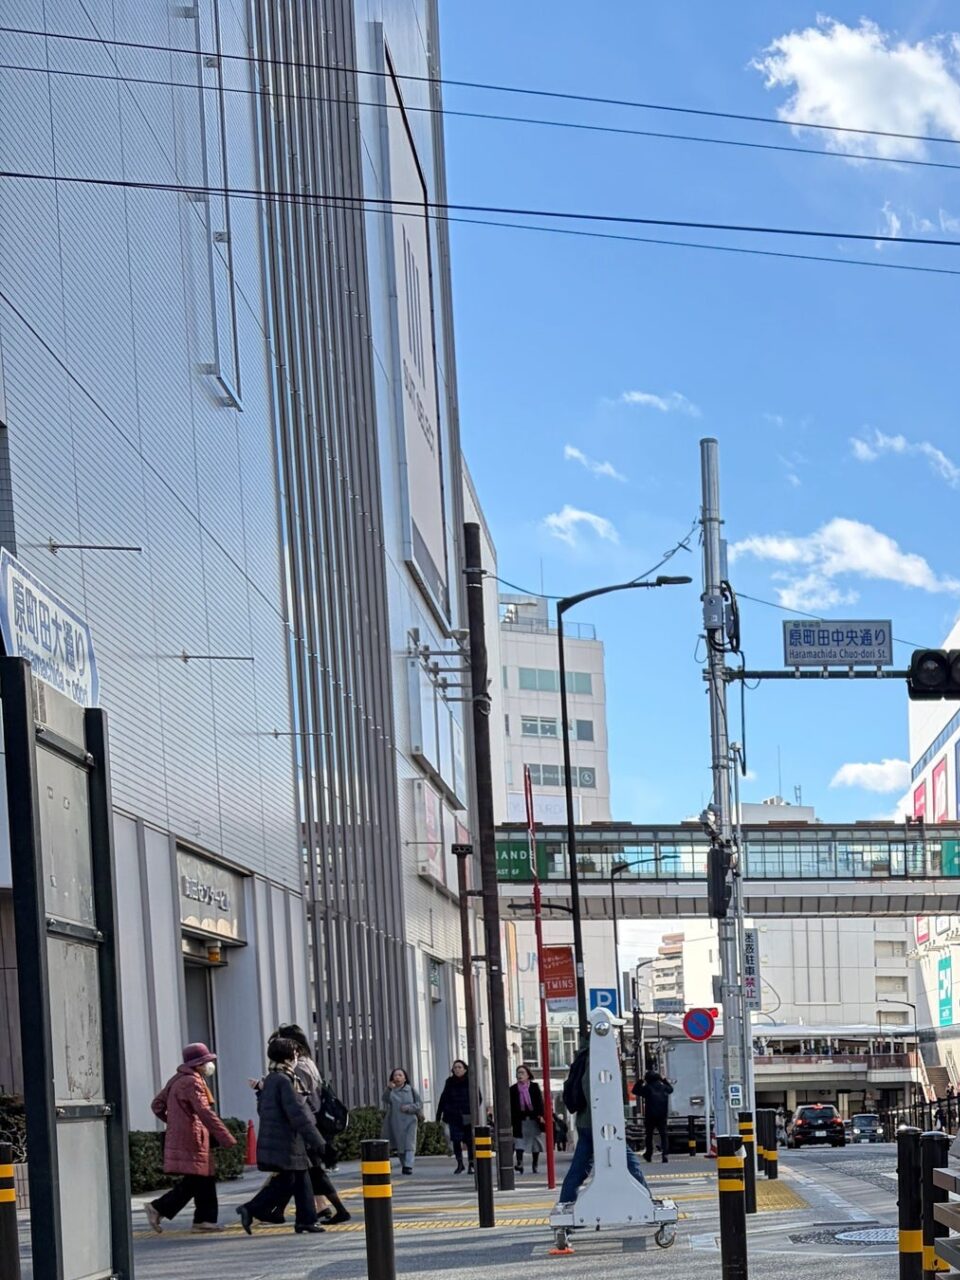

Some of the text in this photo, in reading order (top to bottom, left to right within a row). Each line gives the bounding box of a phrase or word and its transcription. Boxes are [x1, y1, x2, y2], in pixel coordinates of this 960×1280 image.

[12, 576, 87, 677] 原町田大通り
[789, 628, 886, 647] 原町田中央通り
[789, 648, 837, 659] Haramachida
[839, 648, 875, 660] Chuo-dori
[546, 979, 574, 990] TWINS
[596, 991, 612, 1007] P
